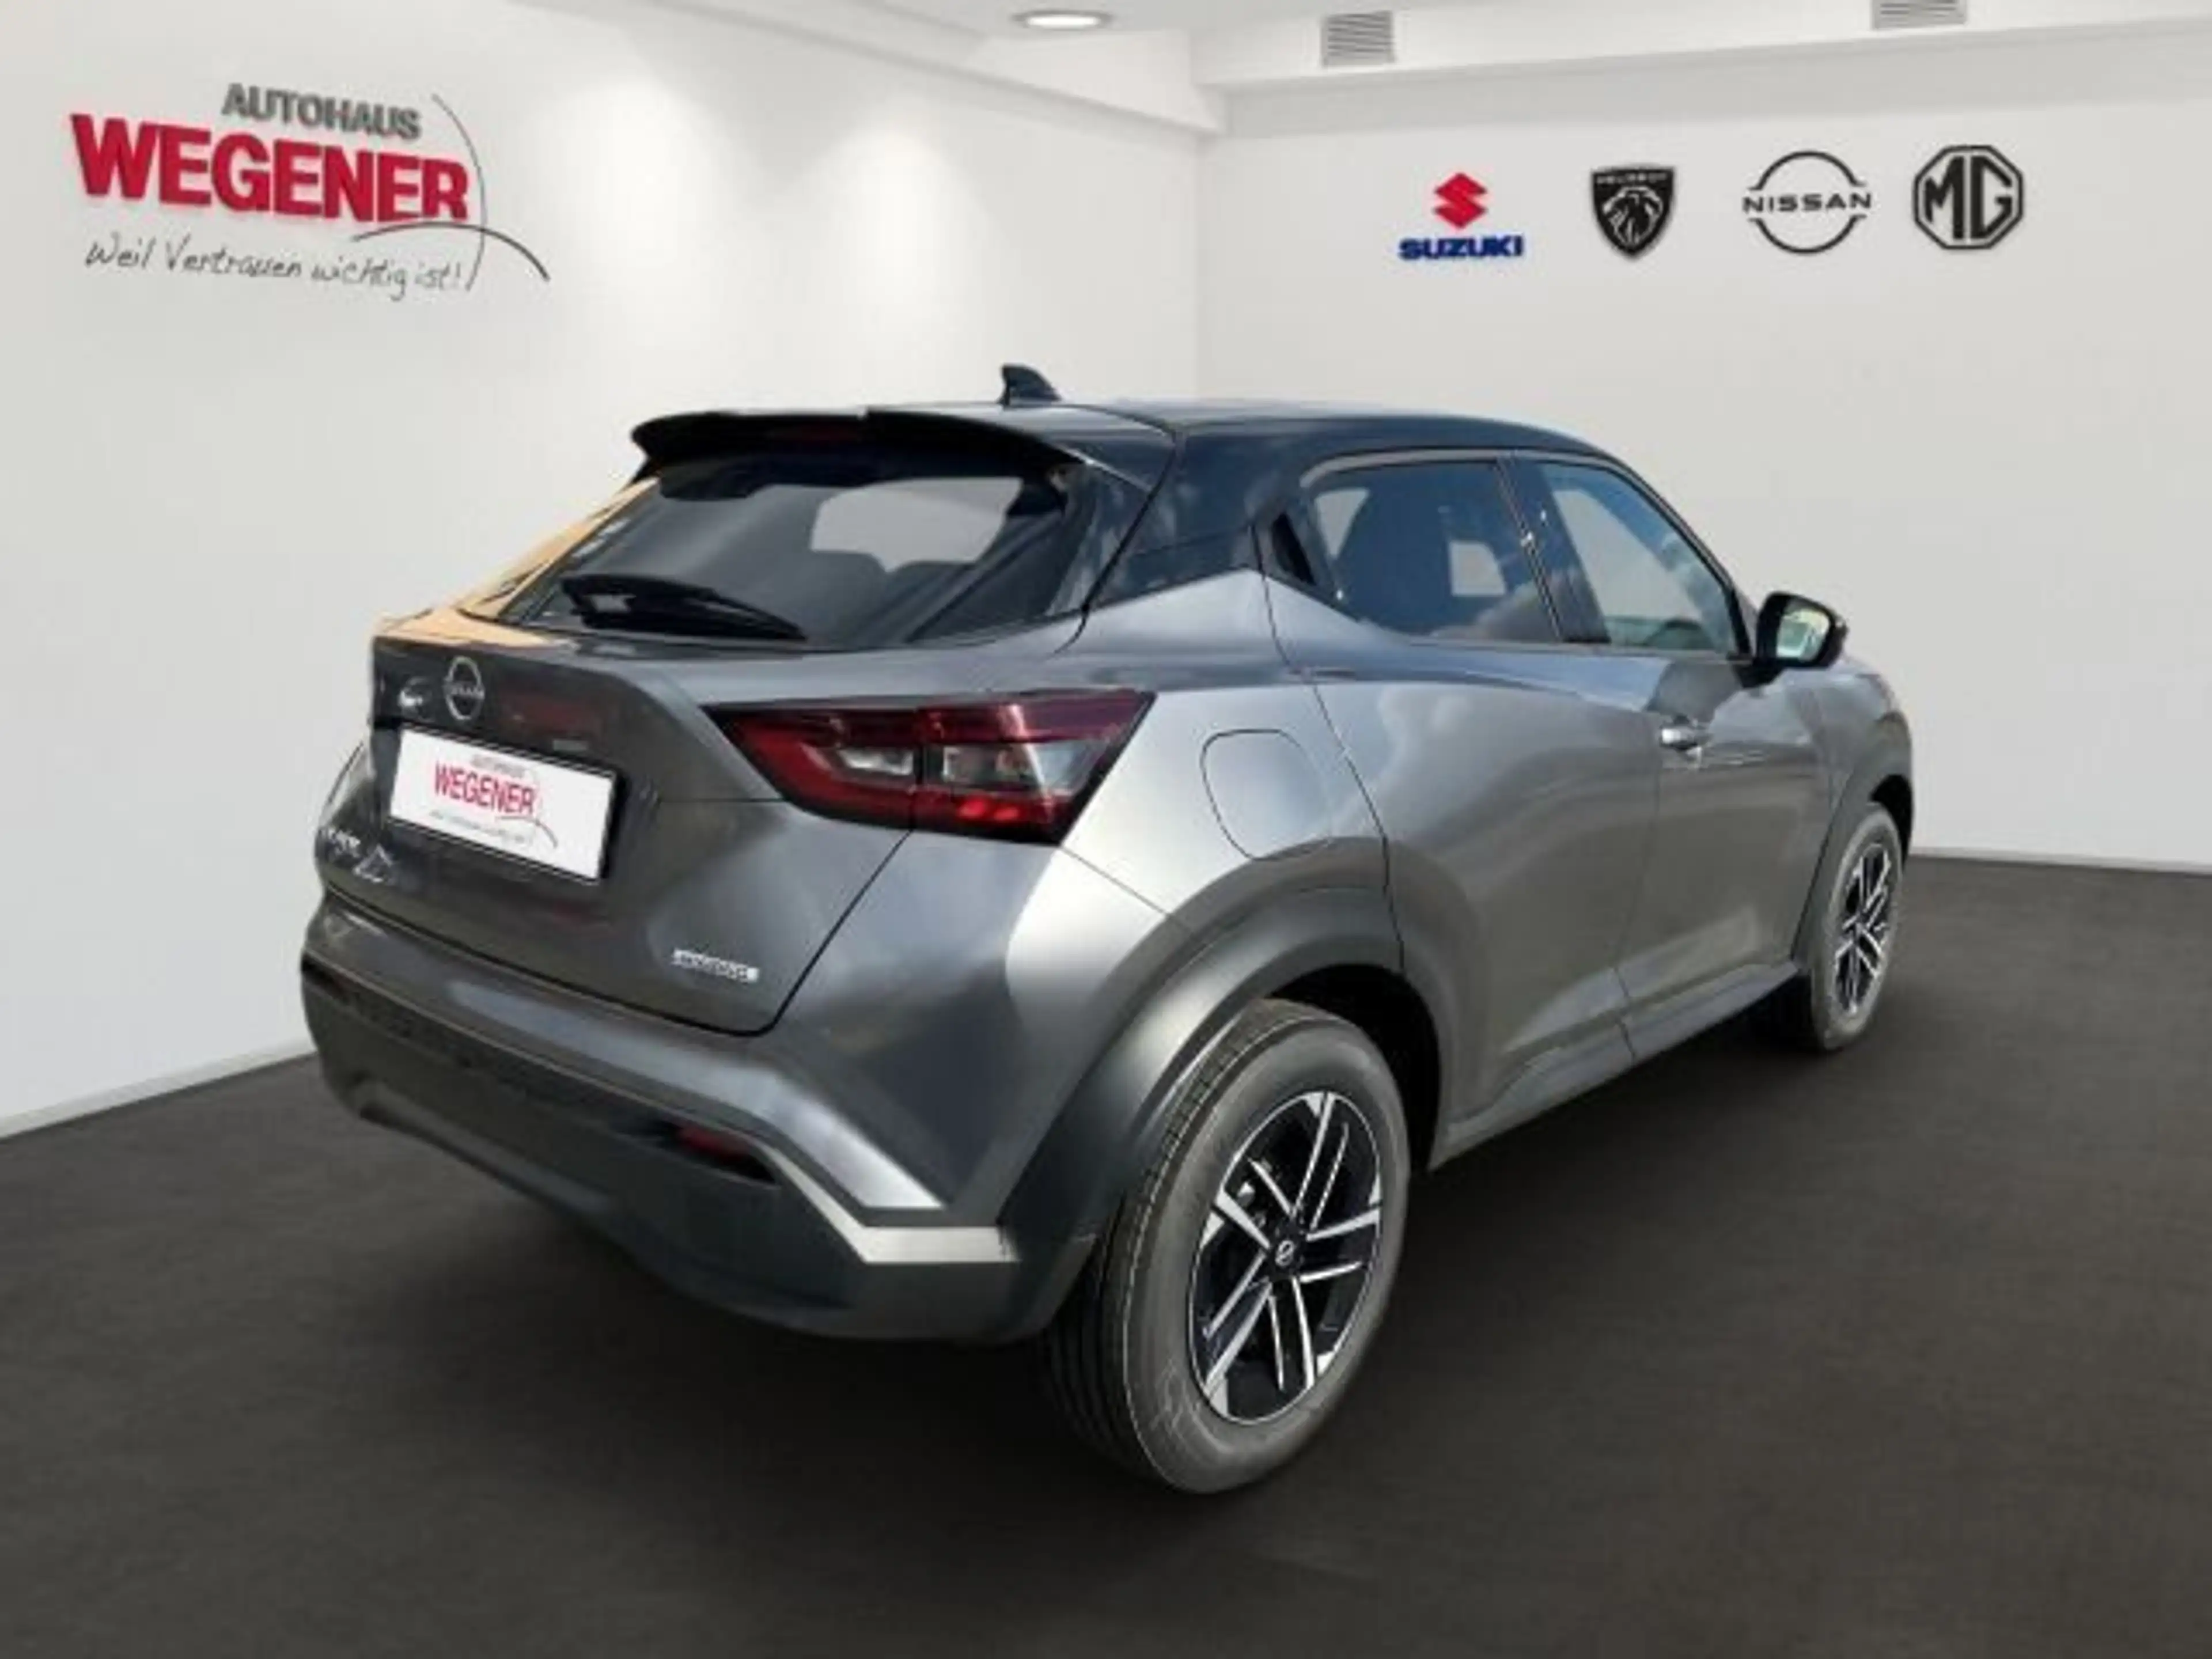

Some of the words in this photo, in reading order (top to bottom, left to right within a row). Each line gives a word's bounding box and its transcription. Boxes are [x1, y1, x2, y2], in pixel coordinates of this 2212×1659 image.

[222, 82, 422, 140] AUTOHAUS
[70, 113, 468, 222] WEGENER
[1743, 193, 1871, 213] NISSAN
[1925, 157, 2013, 241] MG
[85, 230, 157, 268] Weil
[165, 232, 301, 277] Vertrauen
[310, 255, 407, 301] wichtig
[1399, 235, 1524, 260] SUZUKI
[435, 761, 535, 815] WEGENER
